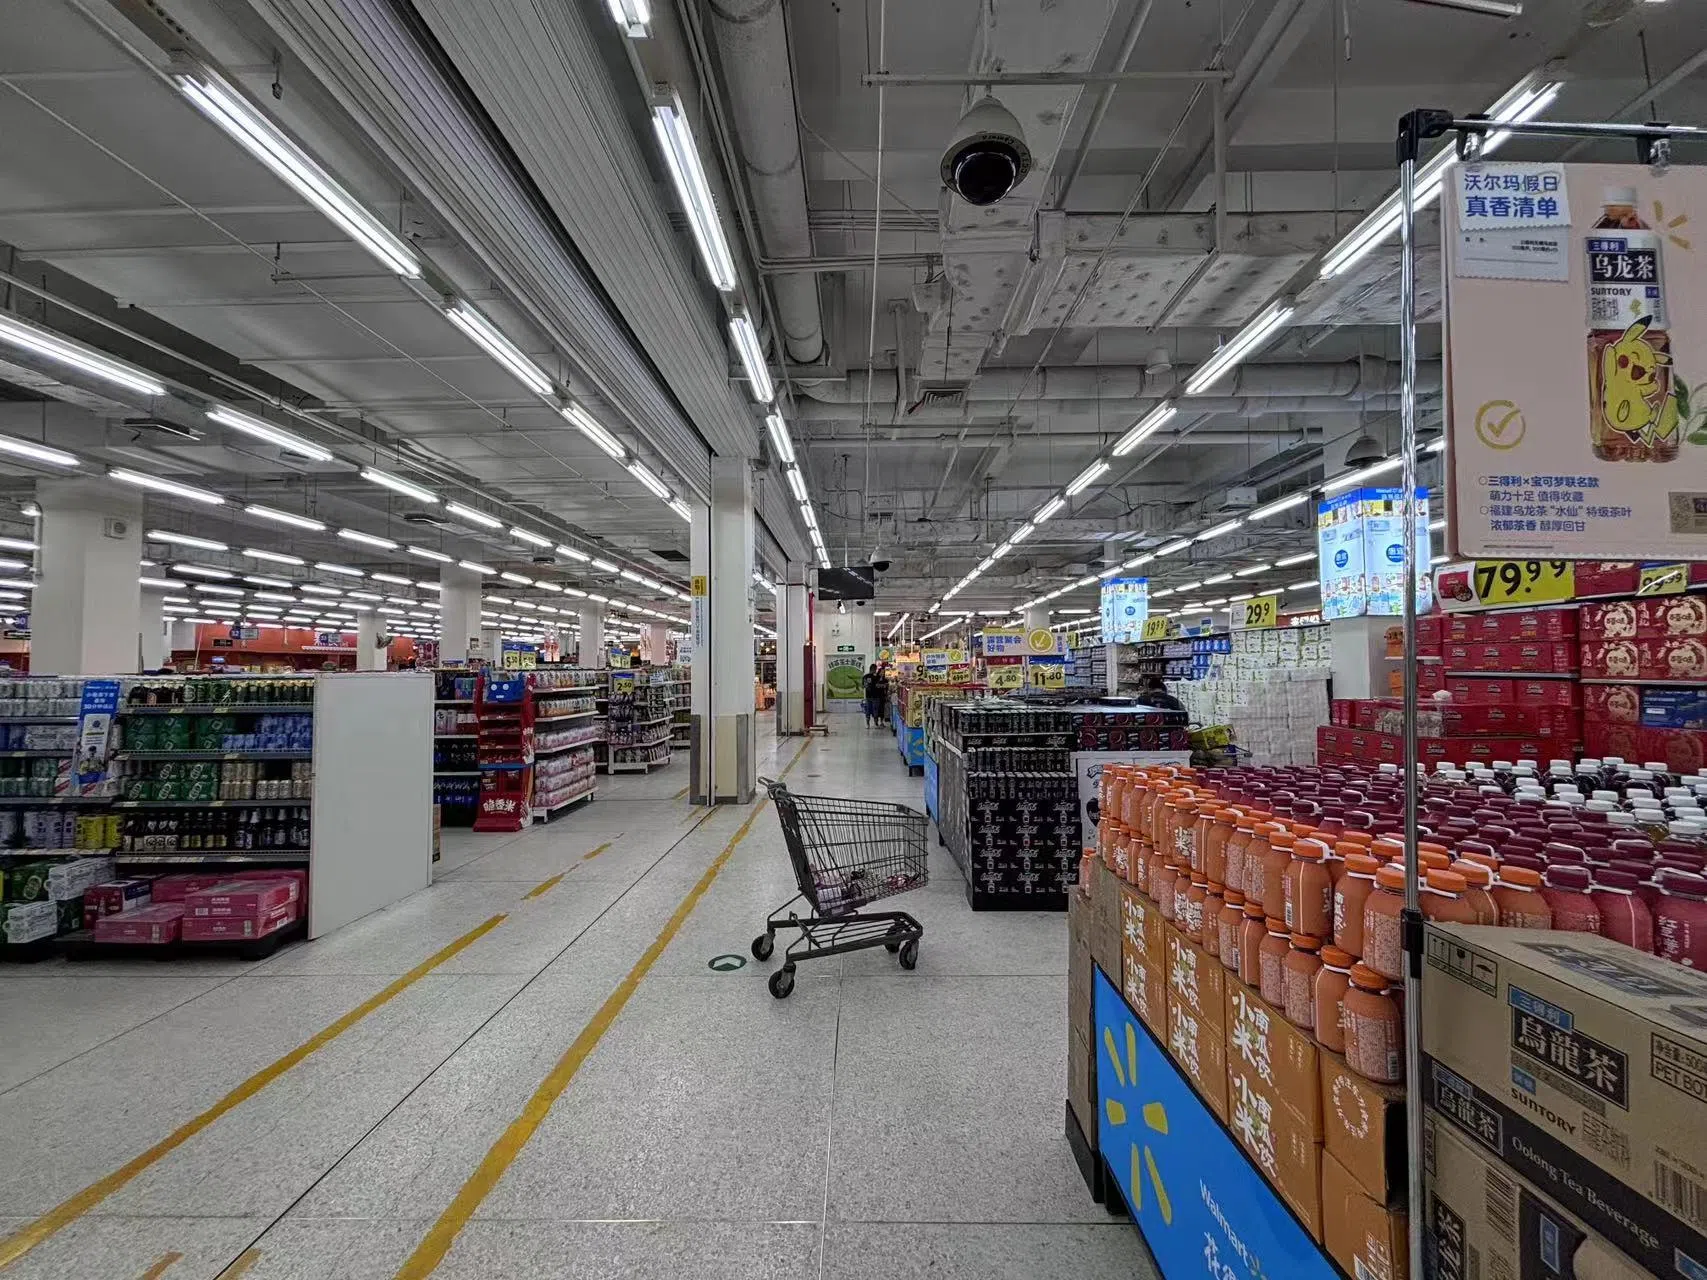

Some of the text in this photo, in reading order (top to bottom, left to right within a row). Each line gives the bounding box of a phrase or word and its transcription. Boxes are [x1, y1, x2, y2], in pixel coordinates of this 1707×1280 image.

[1464, 173, 1558, 192] 沃尔玛假日
[1465, 195, 1559, 218] 真香清单
[1594, 254, 1653, 279] 乌龙茶
[1488, 476, 1600, 488] 三得利×宝可梦联名款
[1489, 490, 1584, 502] 萌力十足 值得收藏
[1490, 520, 1586, 533] 浓郁茶香 醇厚回甘
[1478, 561, 1567, 599] 79.99
[1246, 603, 1270, 625] 29.9
[1517, 1015, 1619, 1094] 烏龍茶
[1655, 1061, 1680, 1085] PET
[1511, 1136, 1558, 1182] Oolong
[1559, 1168, 1583, 1196] Tea
[1584, 1186, 1660, 1249] Beverage
[1200, 1177, 1249, 1268] Walmart
